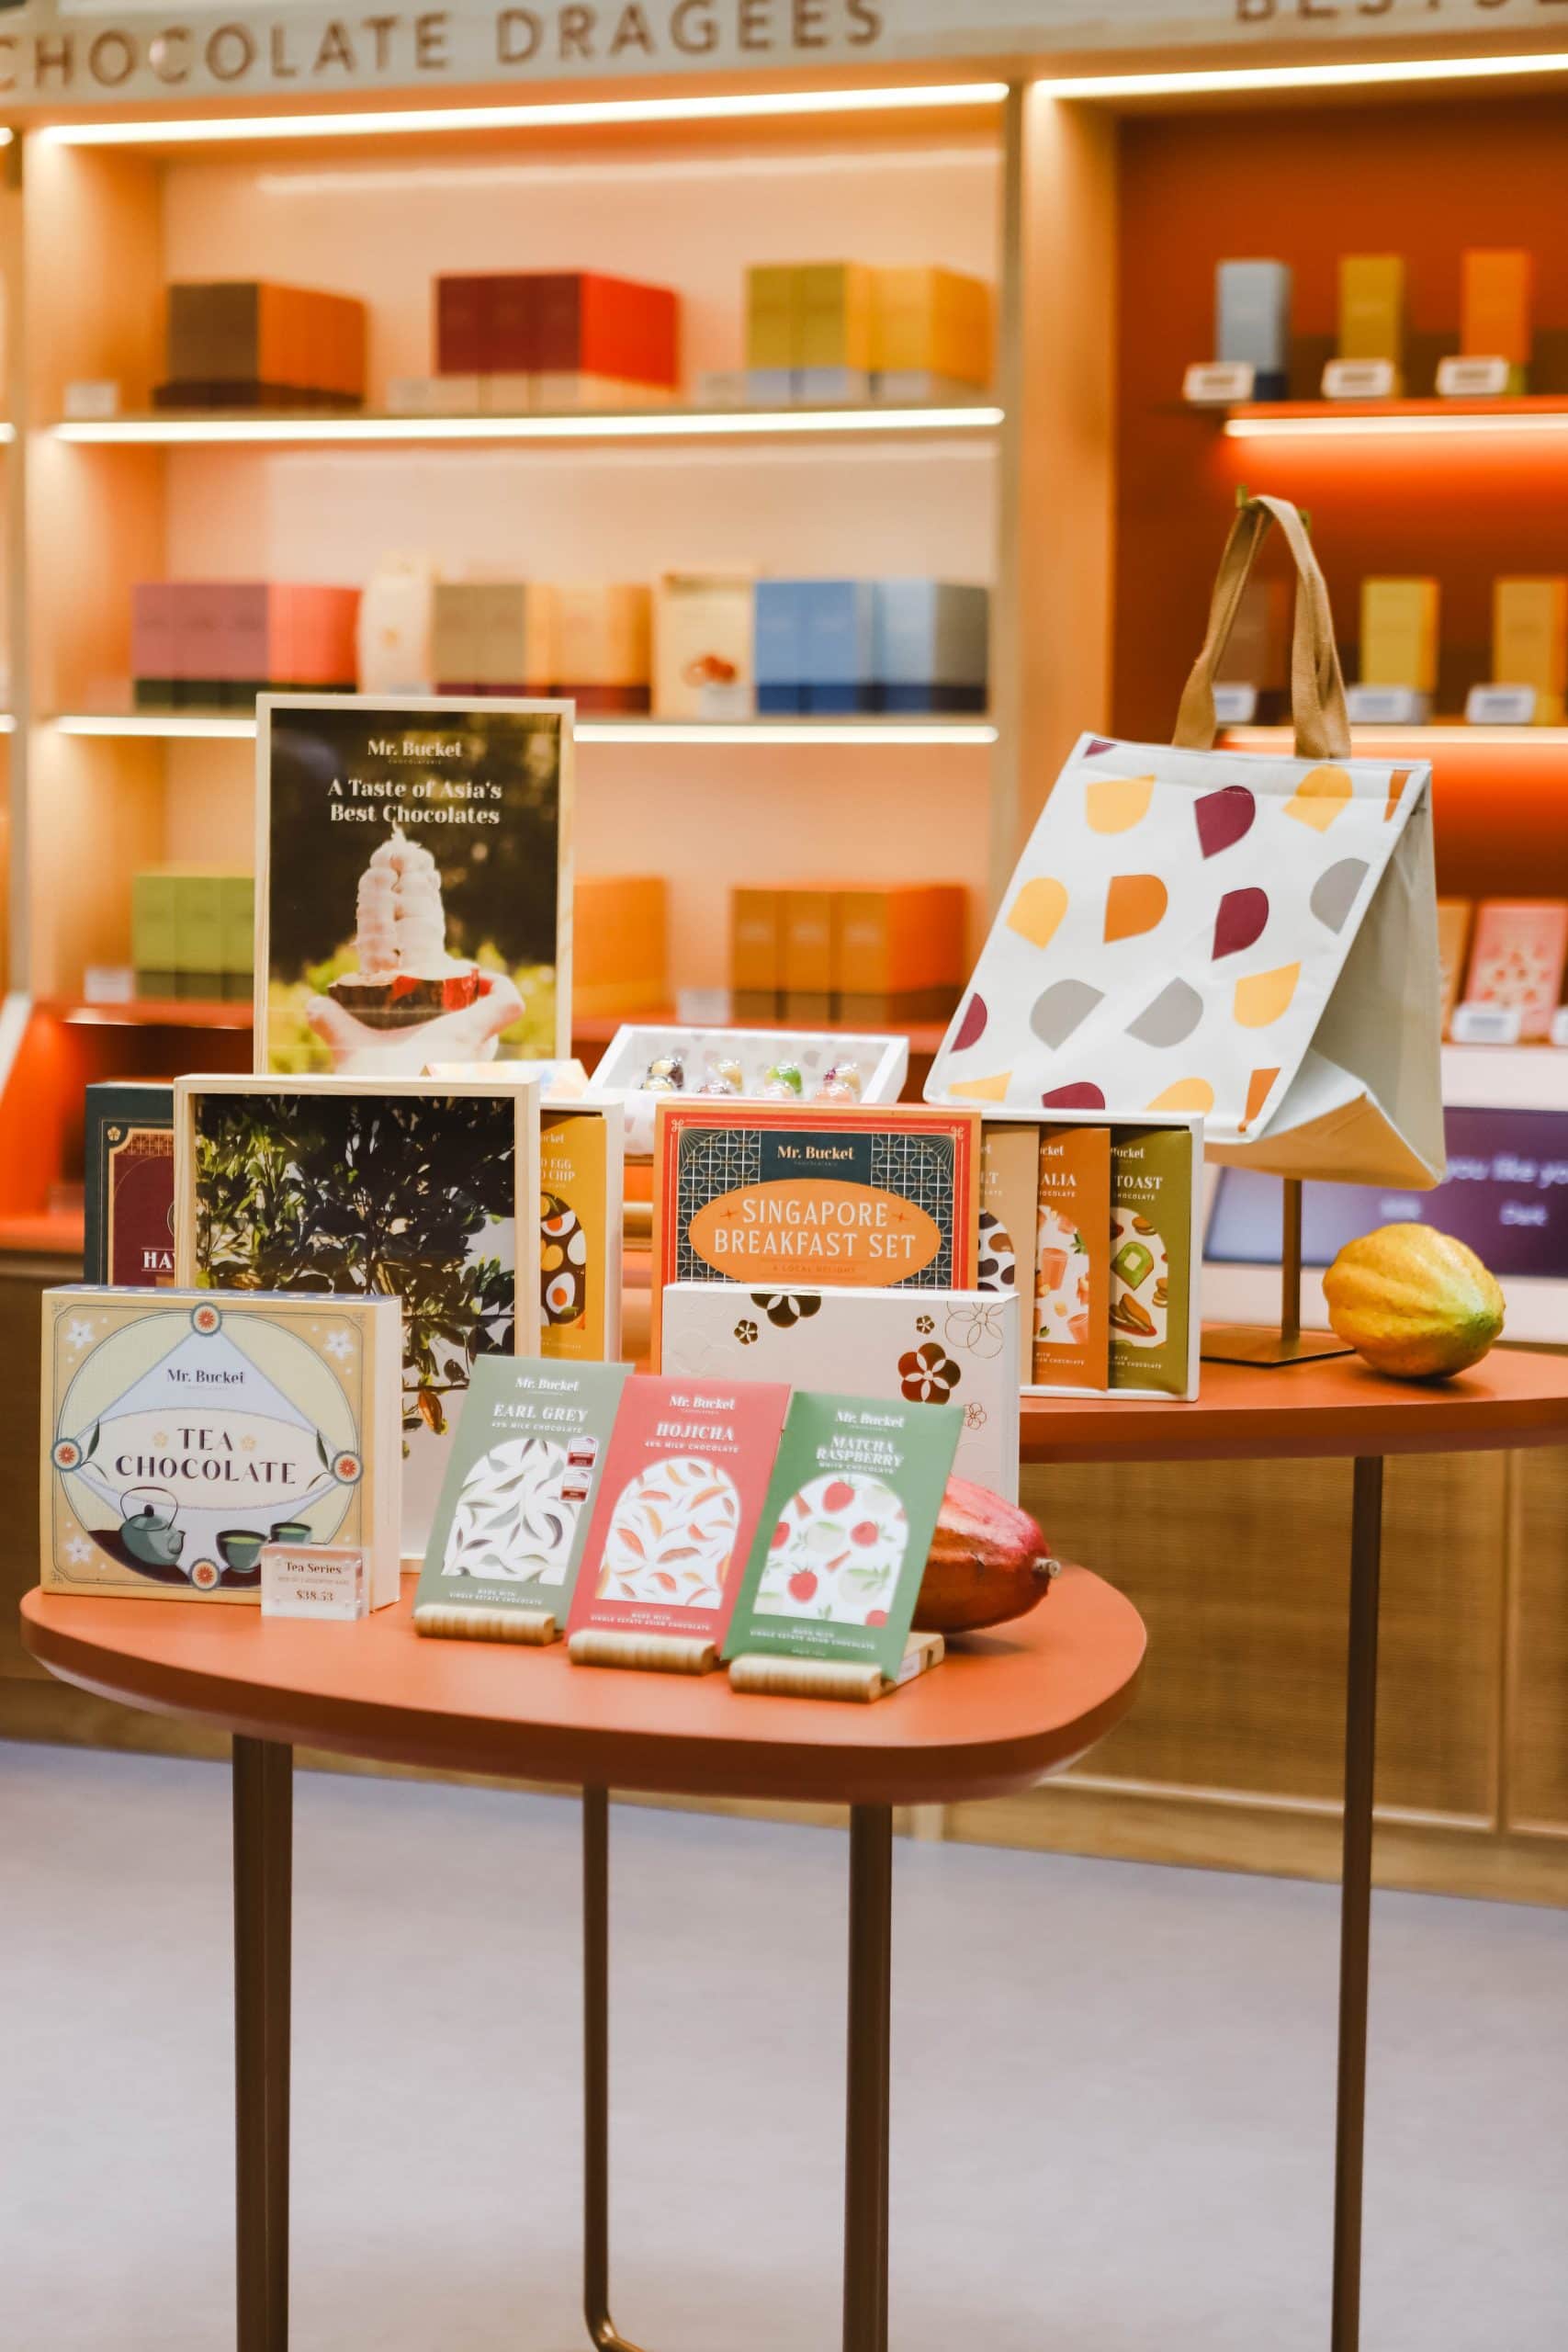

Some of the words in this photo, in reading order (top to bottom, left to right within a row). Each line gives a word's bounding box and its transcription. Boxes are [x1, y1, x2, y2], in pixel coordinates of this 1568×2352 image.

[496, 0, 883, 65] DRAGEES
[367, 739, 398, 757] Mr.
[402, 741, 463, 758] Bucket
[327, 778, 344, 797] A
[348, 778, 407, 797] Taste
[412, 780, 436, 798] of
[440, 780, 502, 799] Asia's
[330, 804, 378, 822] Best
[382, 804, 502, 824] Chocolates
[777, 1146, 802, 1159] Mr.
[806, 1147, 854, 1161] Bucket
[742, 1198, 888, 1227] SINGAPORE
[714, 1228, 858, 1257] BREAKFAST
[869, 1234, 918, 1259] SET
[168, 1369, 191, 1383] Mr.
[196, 1370, 243, 1385] Bucket
[515, 1377, 536, 1389] Mr.
[538, 1378, 580, 1392] Bucket
[670, 1395, 691, 1408] Mr.
[694, 1396, 736, 1410] Bucket
[493, 1403, 536, 1419] EARL
[542, 1406, 589, 1423] GREY
[836, 1410, 858, 1424] Mr.
[861, 1412, 906, 1429] Bucket
[176, 1428, 233, 1452] TEA
[656, 1422, 735, 1442] HOJICHA
[831, 1435, 896, 1454] MATCHA
[816, 1448, 905, 1468] RASPBERRY
[115, 1454, 297, 1485] CHOCOLATE
[286, 1561, 305, 1573] Tea
[308, 1563, 343, 1575] Series
